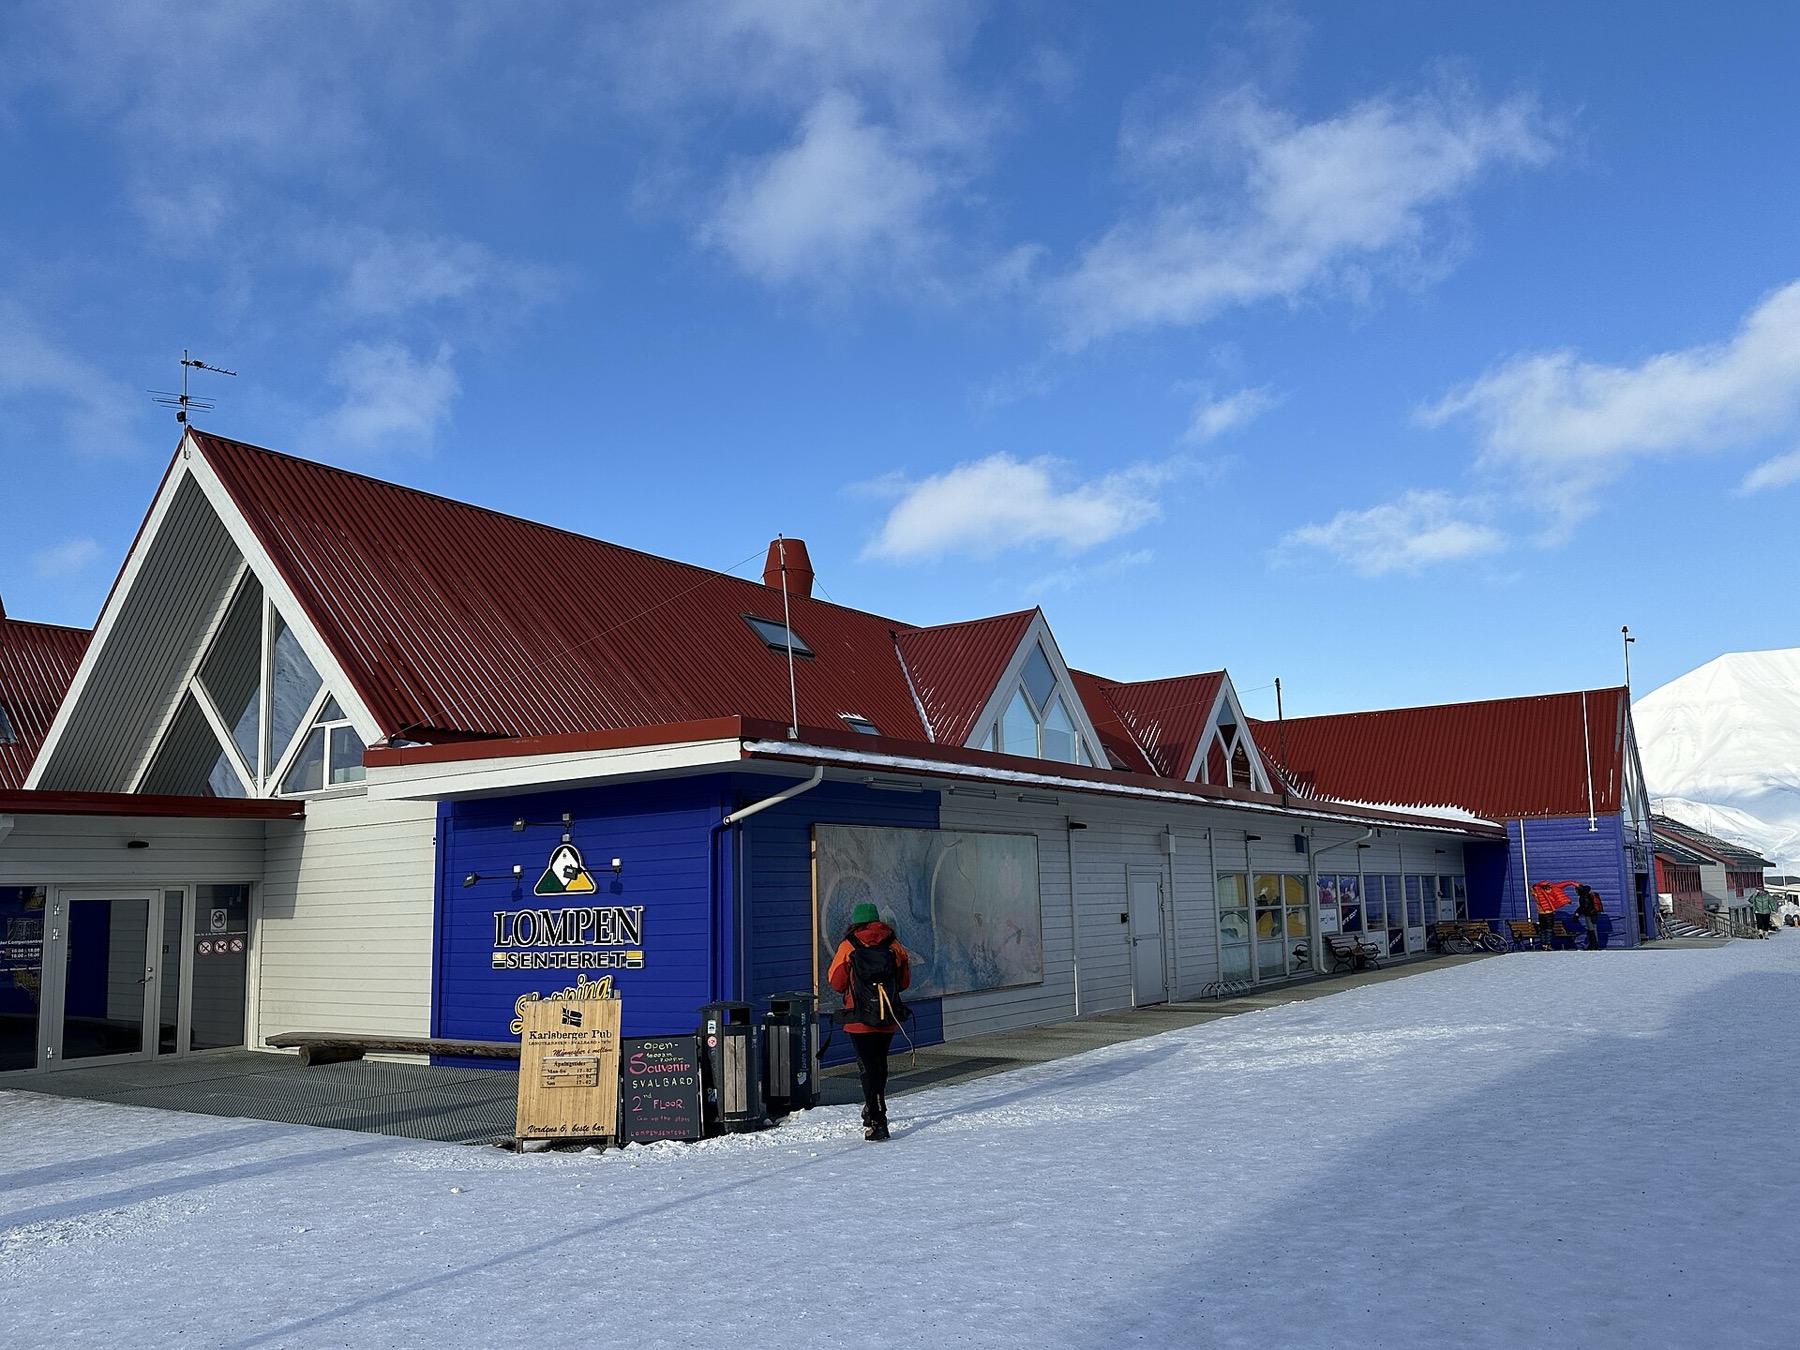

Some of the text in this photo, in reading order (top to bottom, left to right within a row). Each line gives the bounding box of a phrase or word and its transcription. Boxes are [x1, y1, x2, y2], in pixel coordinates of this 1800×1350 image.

[493, 905, 644, 948] LOMPEN
[506, 950, 626, 969] SENTERET
[529, 1029, 612, 1040] Karlsberger Pub
[643, 1042, 673, 1051] Open
[629, 1052, 691, 1075] Souvenir
[632, 1077, 693, 1089] SVALBARD
[527, 1124, 558, 1133] Verdens
[571, 1123, 590, 1132] beste
[591, 1122, 605, 1132] bar
